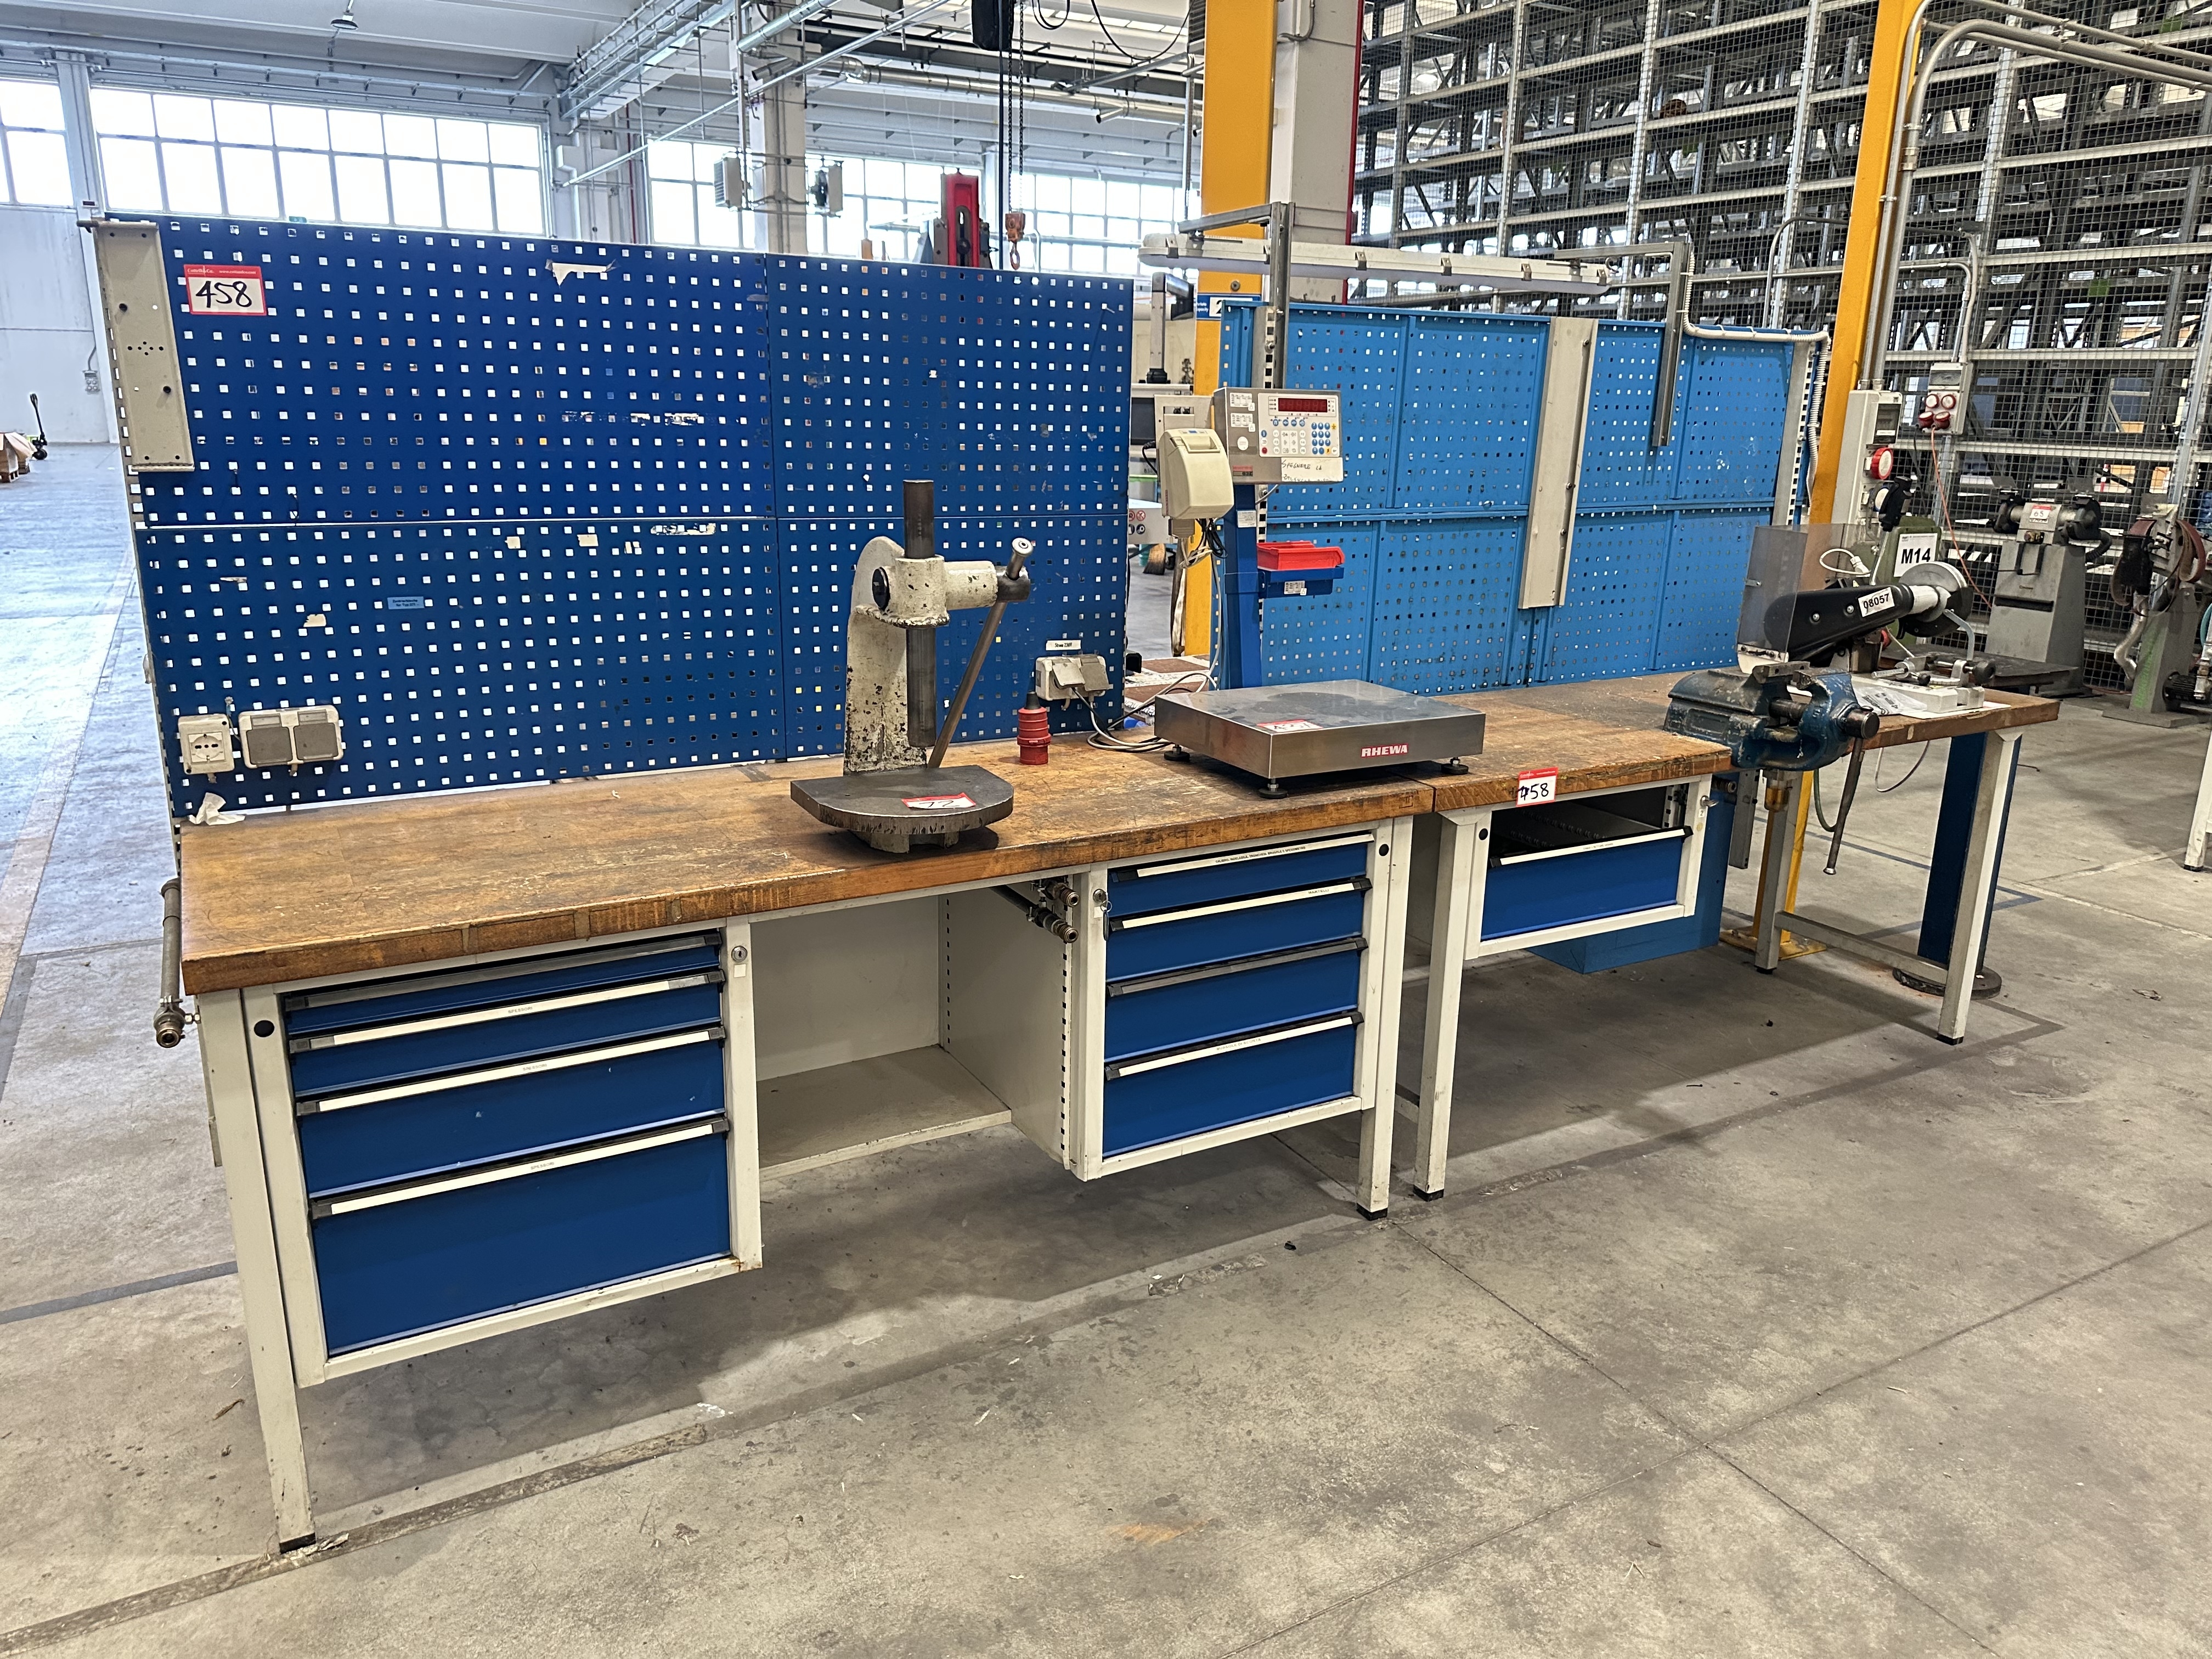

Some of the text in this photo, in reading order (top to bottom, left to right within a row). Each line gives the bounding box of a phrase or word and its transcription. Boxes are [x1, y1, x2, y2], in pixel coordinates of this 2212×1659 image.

[196, 280, 252, 308] 458
[1901, 548, 1931, 564] M14
[1863, 593, 1889, 609] 08057
[1361, 744, 1408, 758] RHEWA
[522, 1063, 548, 1071] SPESSORI
